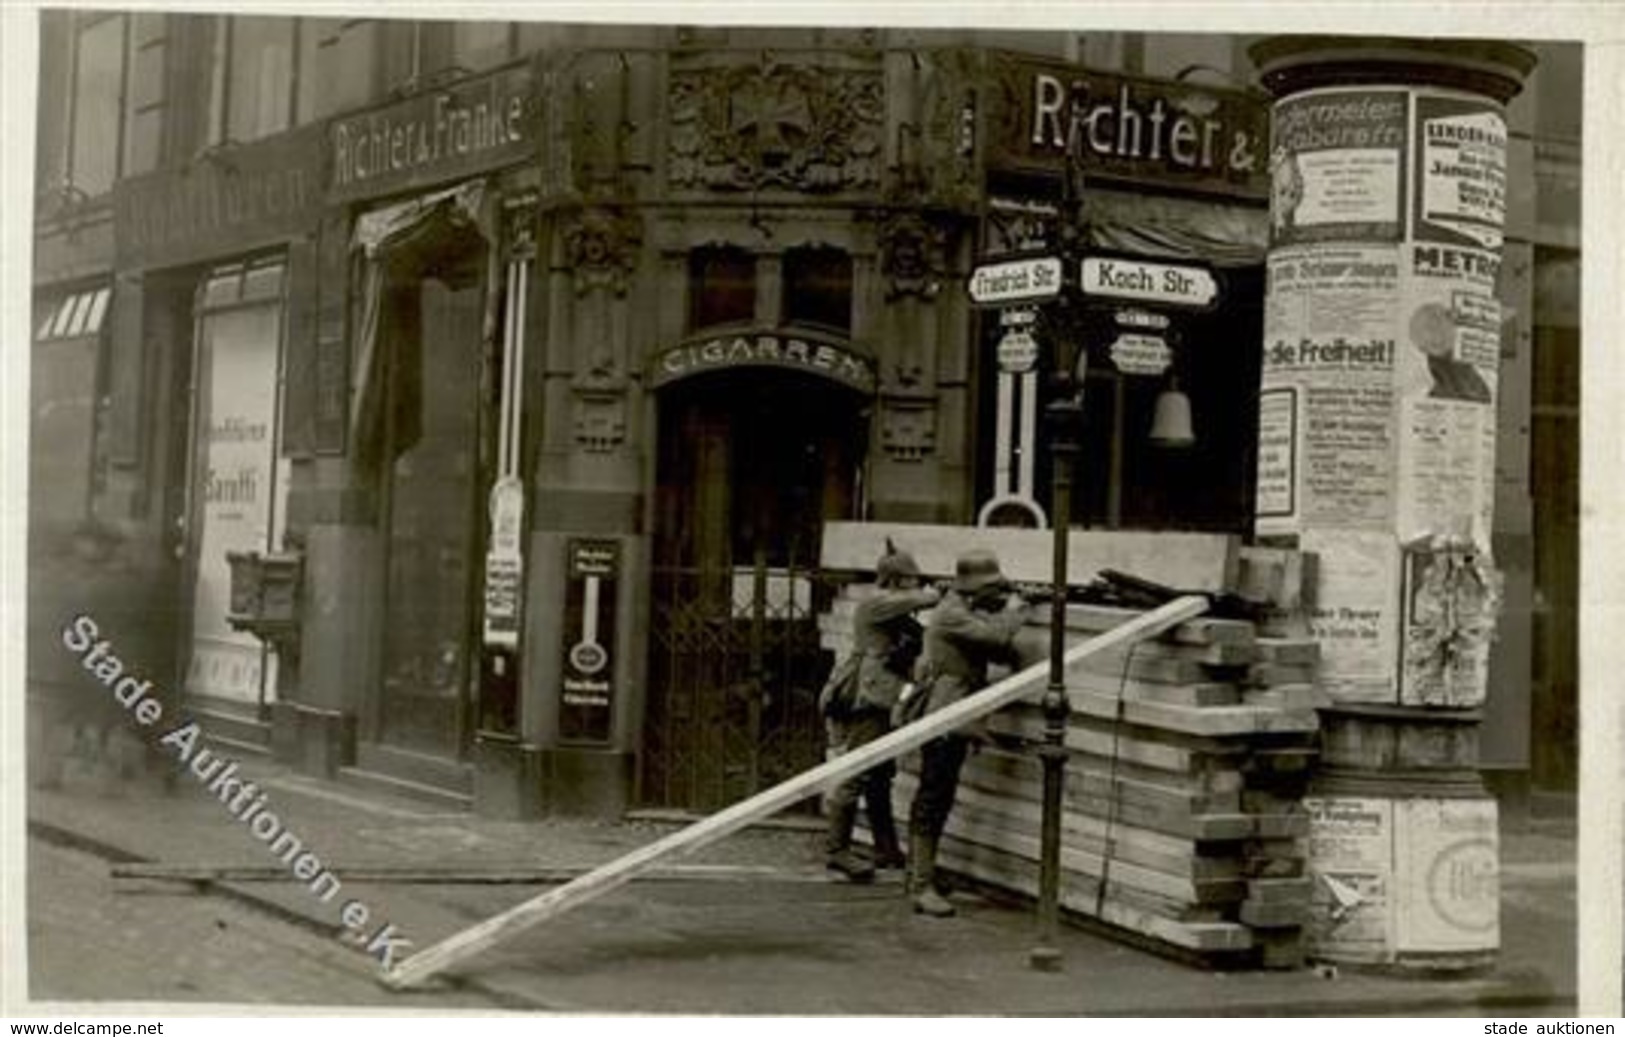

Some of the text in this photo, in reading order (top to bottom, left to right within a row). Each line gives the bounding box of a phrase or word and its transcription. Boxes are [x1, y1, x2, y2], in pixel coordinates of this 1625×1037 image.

[1032, 73, 1221, 167] Richter
[1230, 132, 1254, 169] &
[976, 268, 1029, 296] Friedrich
[1097, 261, 1199, 297] Koch Str.
[663, 336, 868, 381] CIGARREN
[1300, 337, 1395, 365] Freiheit!
